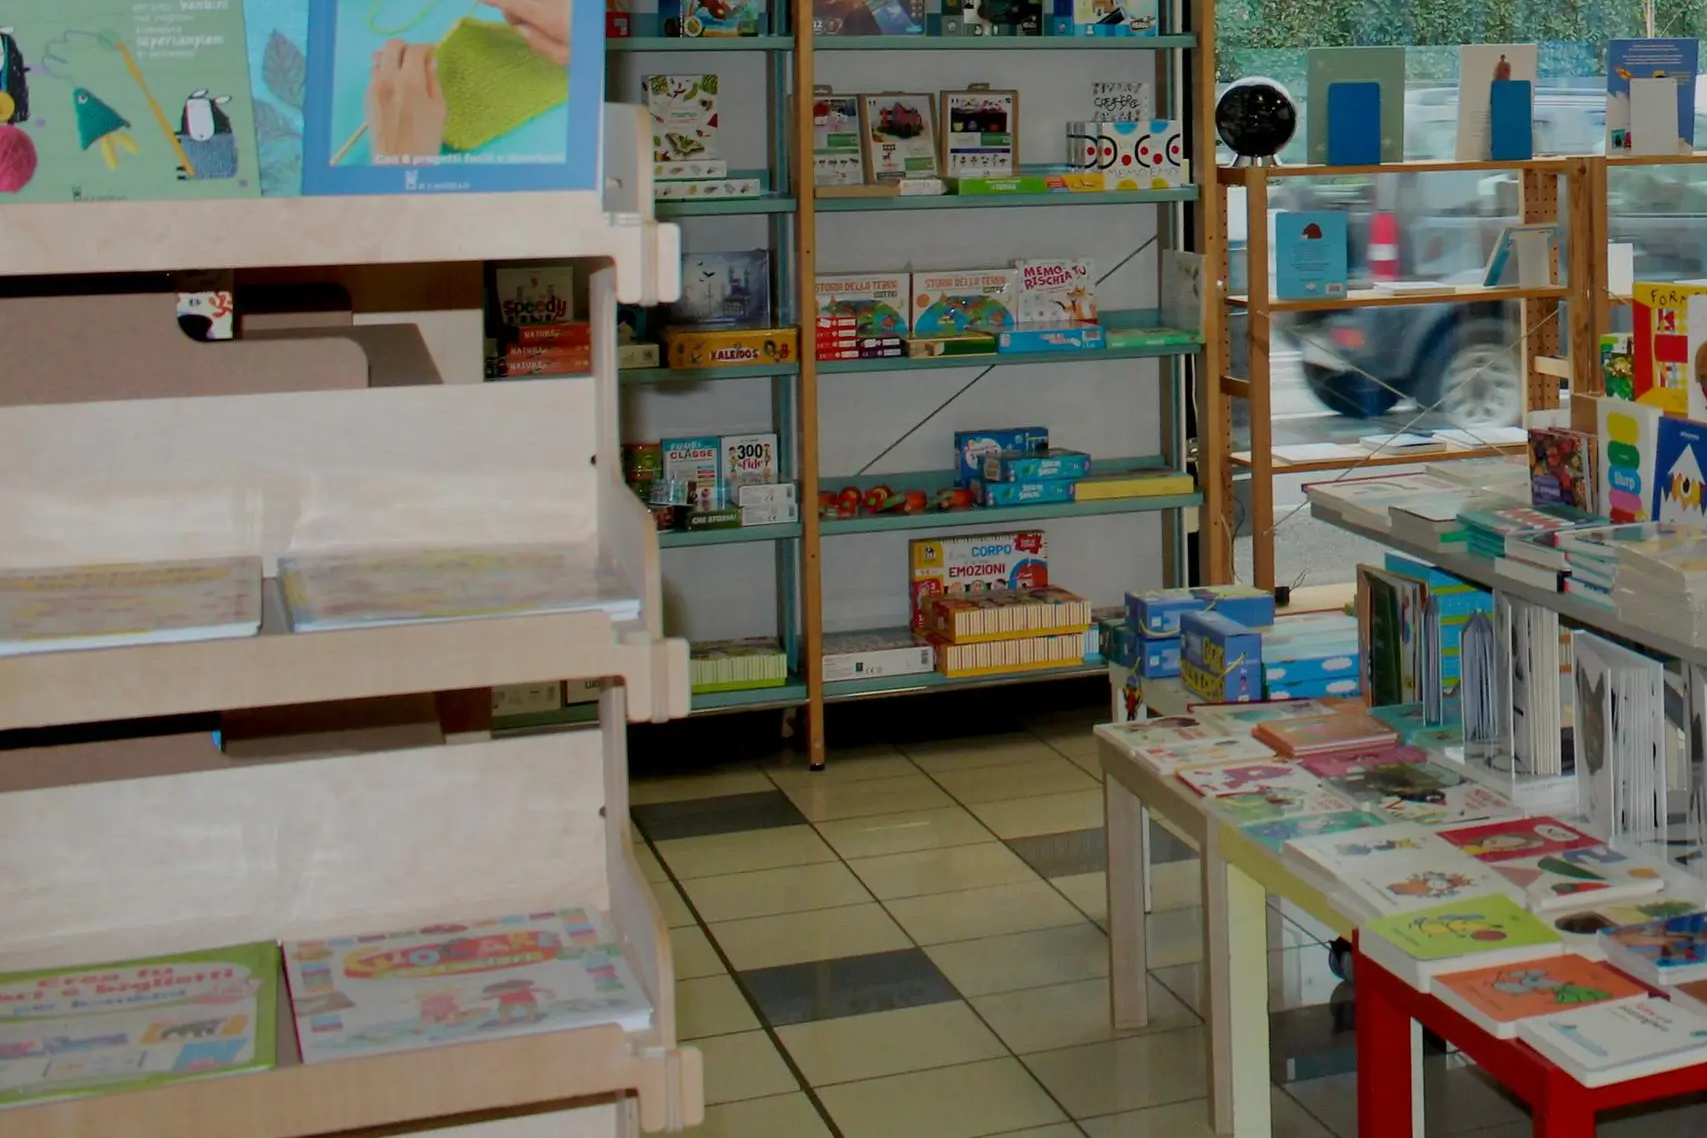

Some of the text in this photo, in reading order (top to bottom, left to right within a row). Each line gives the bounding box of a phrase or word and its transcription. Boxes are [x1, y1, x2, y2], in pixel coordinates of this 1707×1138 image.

[1024, 265, 1063, 278] MEMO
[1024, 271, 1073, 290] RISCHIA
[503, 295, 567, 318] speedy
[737, 443, 763, 460] 300
[972, 544, 1012, 557] CORPO
[949, 563, 1006, 578] EMOZIONI
